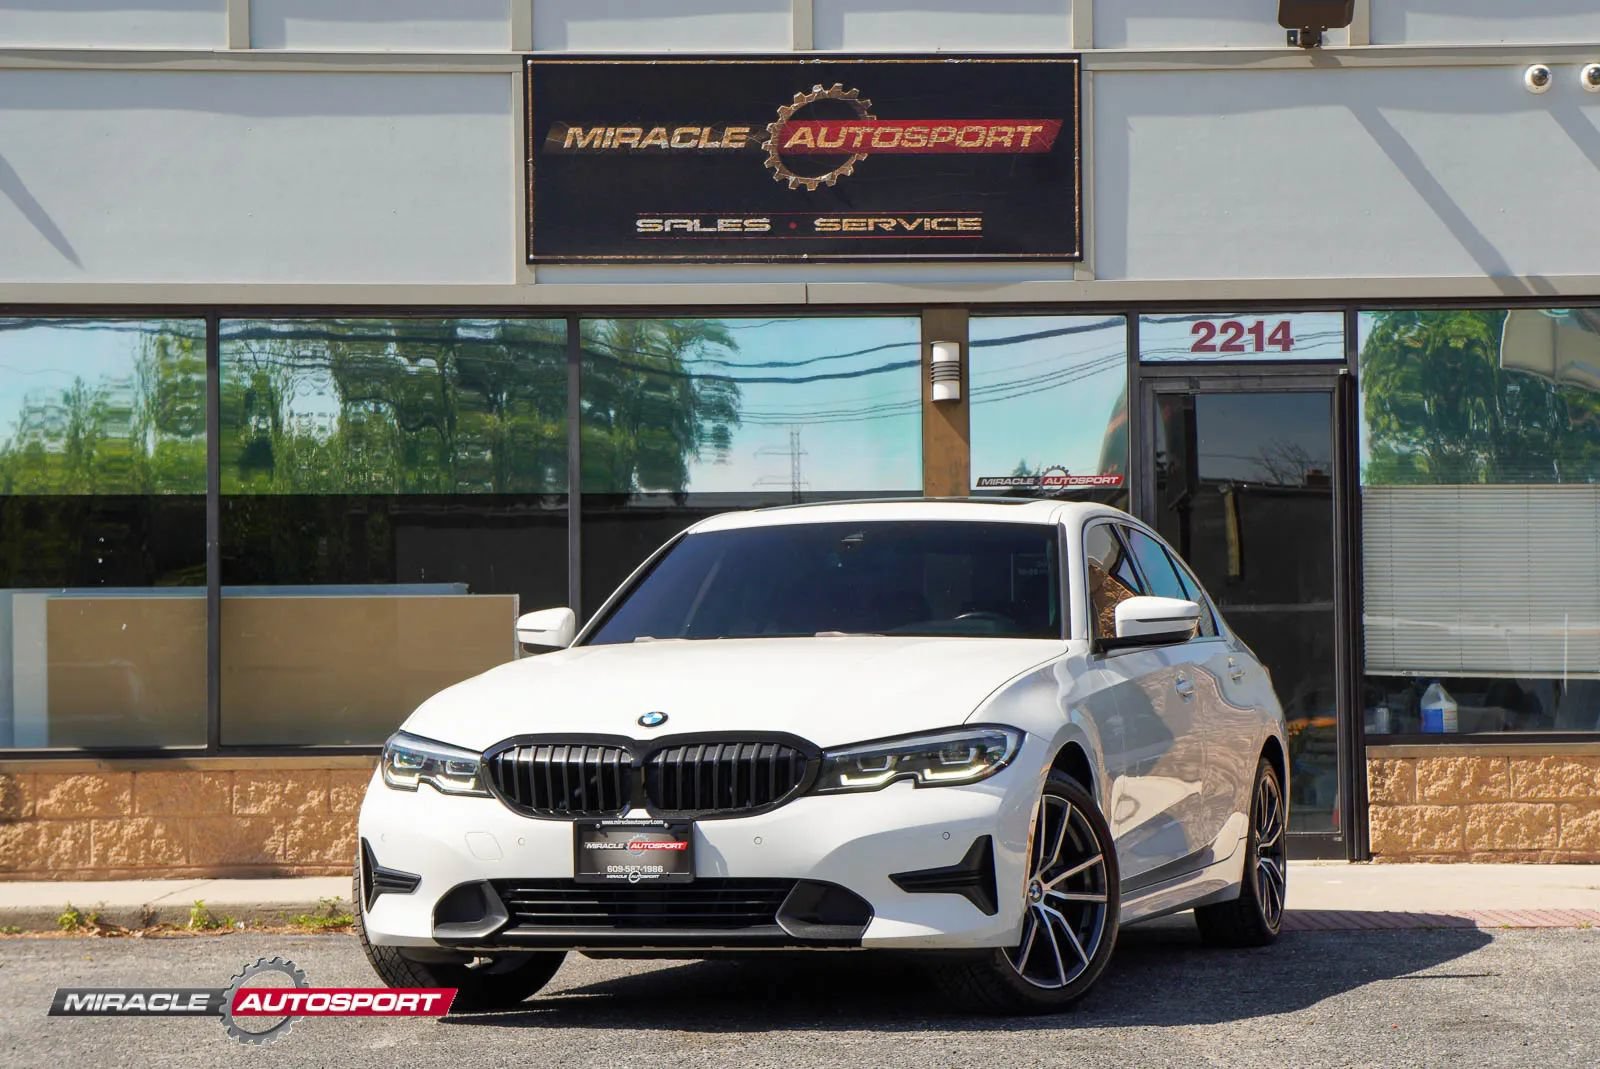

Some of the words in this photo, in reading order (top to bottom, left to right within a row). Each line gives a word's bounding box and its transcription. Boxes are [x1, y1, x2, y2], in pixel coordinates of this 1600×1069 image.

[562, 126, 751, 150] MIRACLE
[783, 124, 1043, 149] AUTOSPORT
[635, 217, 772, 233] SALES
[813, 216, 983, 232] SERVICE
[1190, 320, 1295, 352] 2214
[981, 477, 1035, 486] MIRACLE
[1044, 476, 1119, 485] AUTOSPORT
